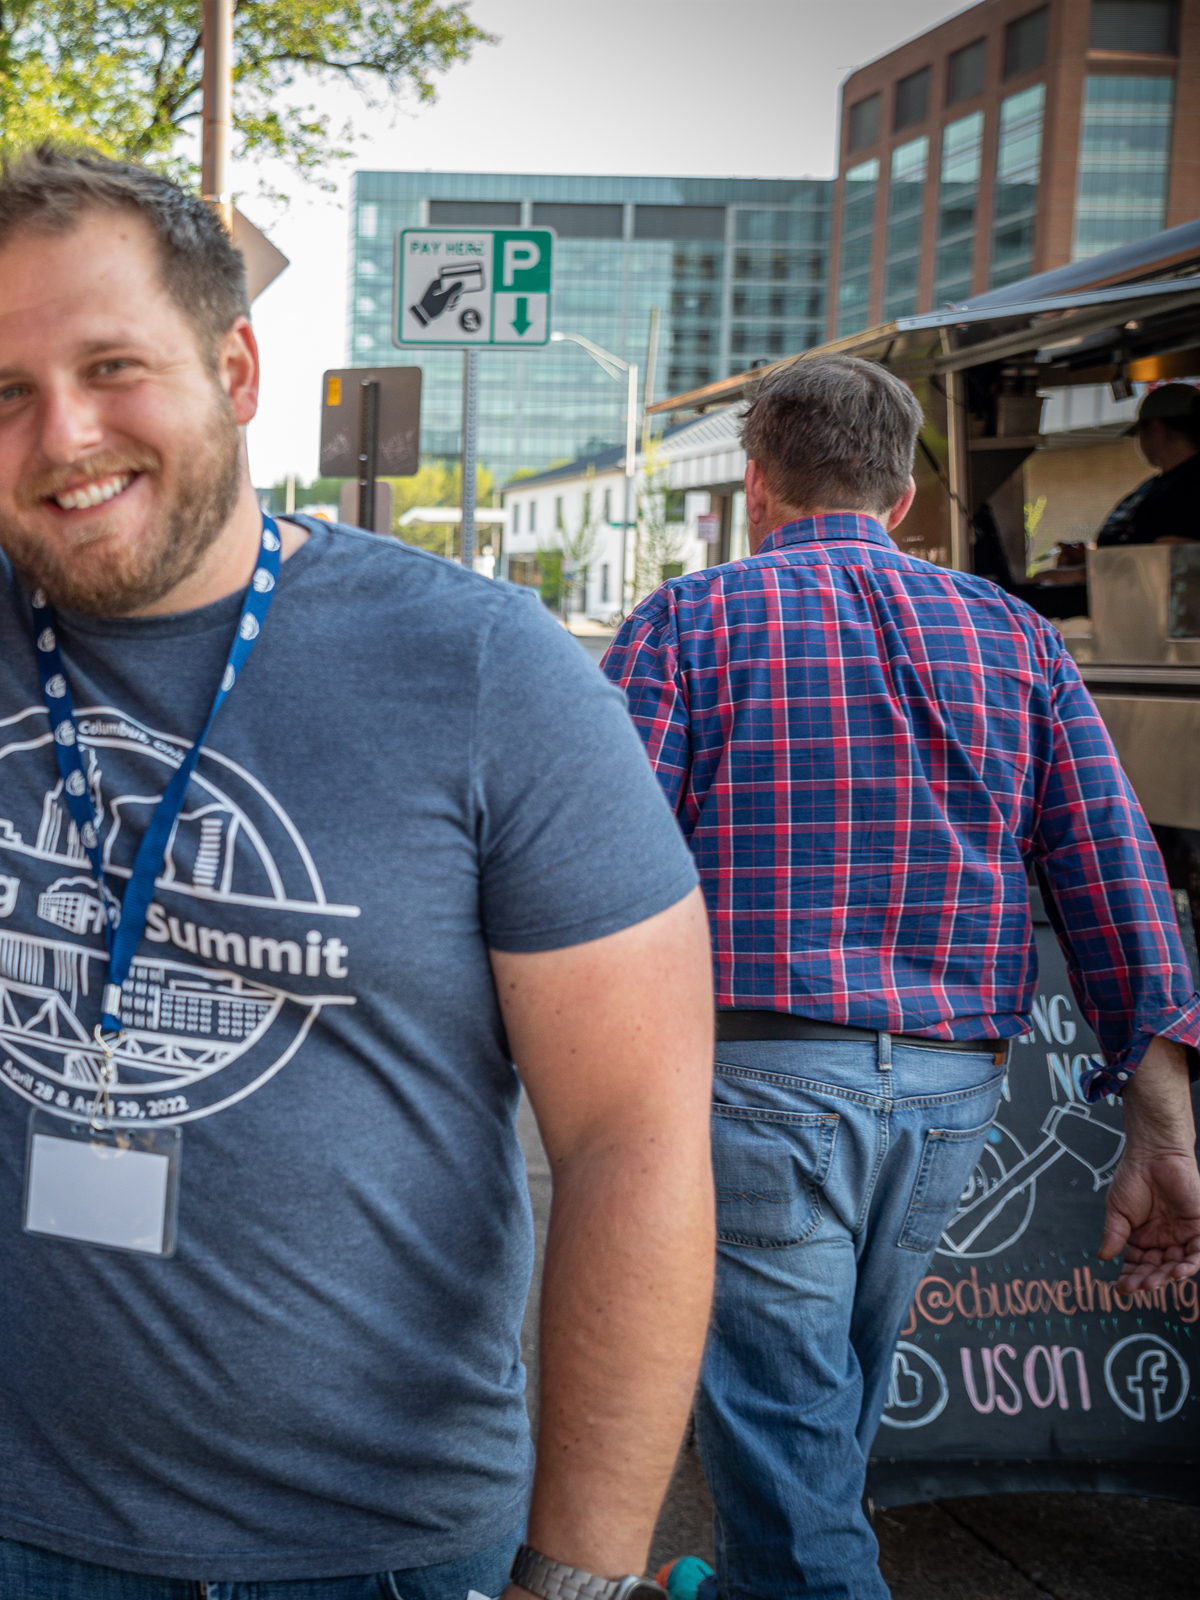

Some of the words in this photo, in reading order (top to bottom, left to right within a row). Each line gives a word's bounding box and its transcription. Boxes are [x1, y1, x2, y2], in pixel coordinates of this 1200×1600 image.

[410, 240, 442, 255] PAY
[445, 241, 485, 256] HERE
[503, 240, 541, 286] P
[78, 719, 151, 745] Columbus,
[145, 902, 350, 978] Summit
[1018, 994, 1076, 1045] NG
[2, 1059, 34, 1091] April
[33, 1080, 55, 1101] 28
[55, 1090, 70, 1107] &
[73, 1095, 115, 1116] Aprl
[117, 1100, 146, 1119] 29,
[146, 1094, 190, 1116] 2022
